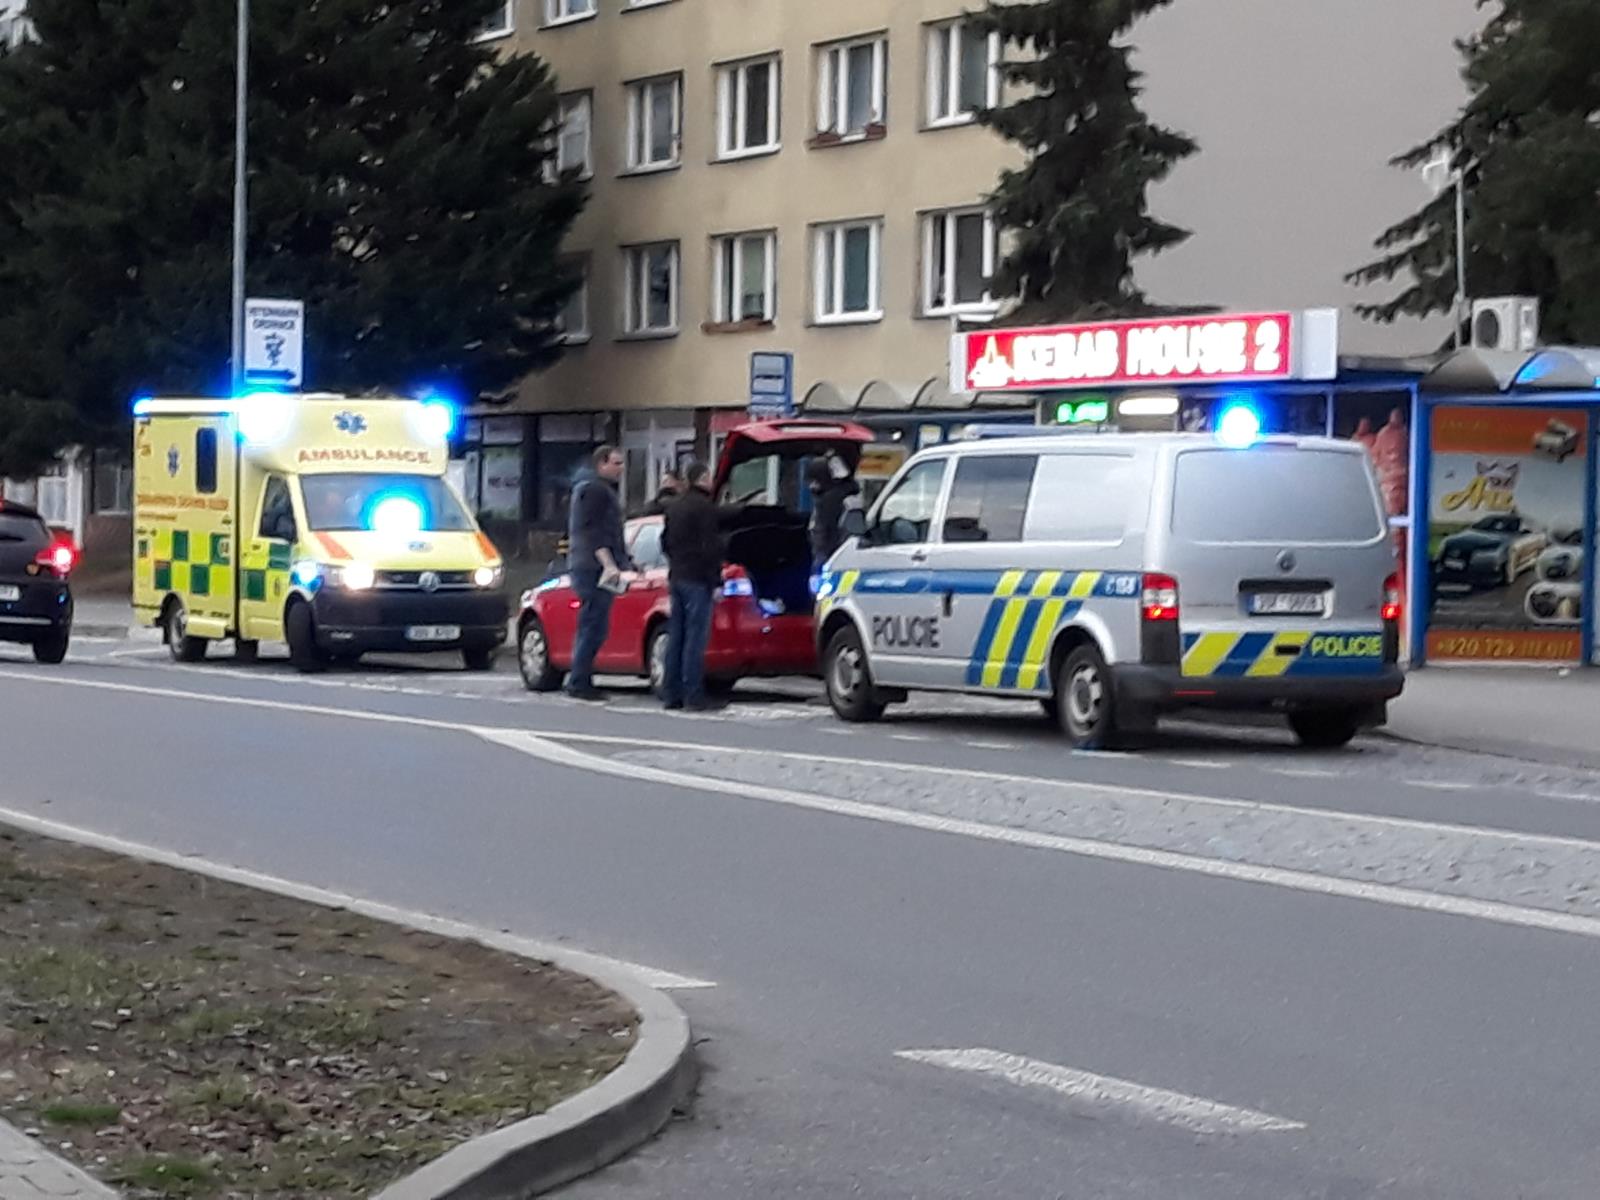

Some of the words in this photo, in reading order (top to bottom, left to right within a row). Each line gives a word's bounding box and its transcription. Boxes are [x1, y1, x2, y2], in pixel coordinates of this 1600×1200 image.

[1012, 329, 1119, 381] KEBAB
[1126, 321, 1248, 376] HOUSE
[1254, 320, 1281, 373] 2
[298, 449, 431, 464] AMBULANCE
[872, 615, 940, 649] POLICIE
[1311, 636, 1382, 657] POLICIE
